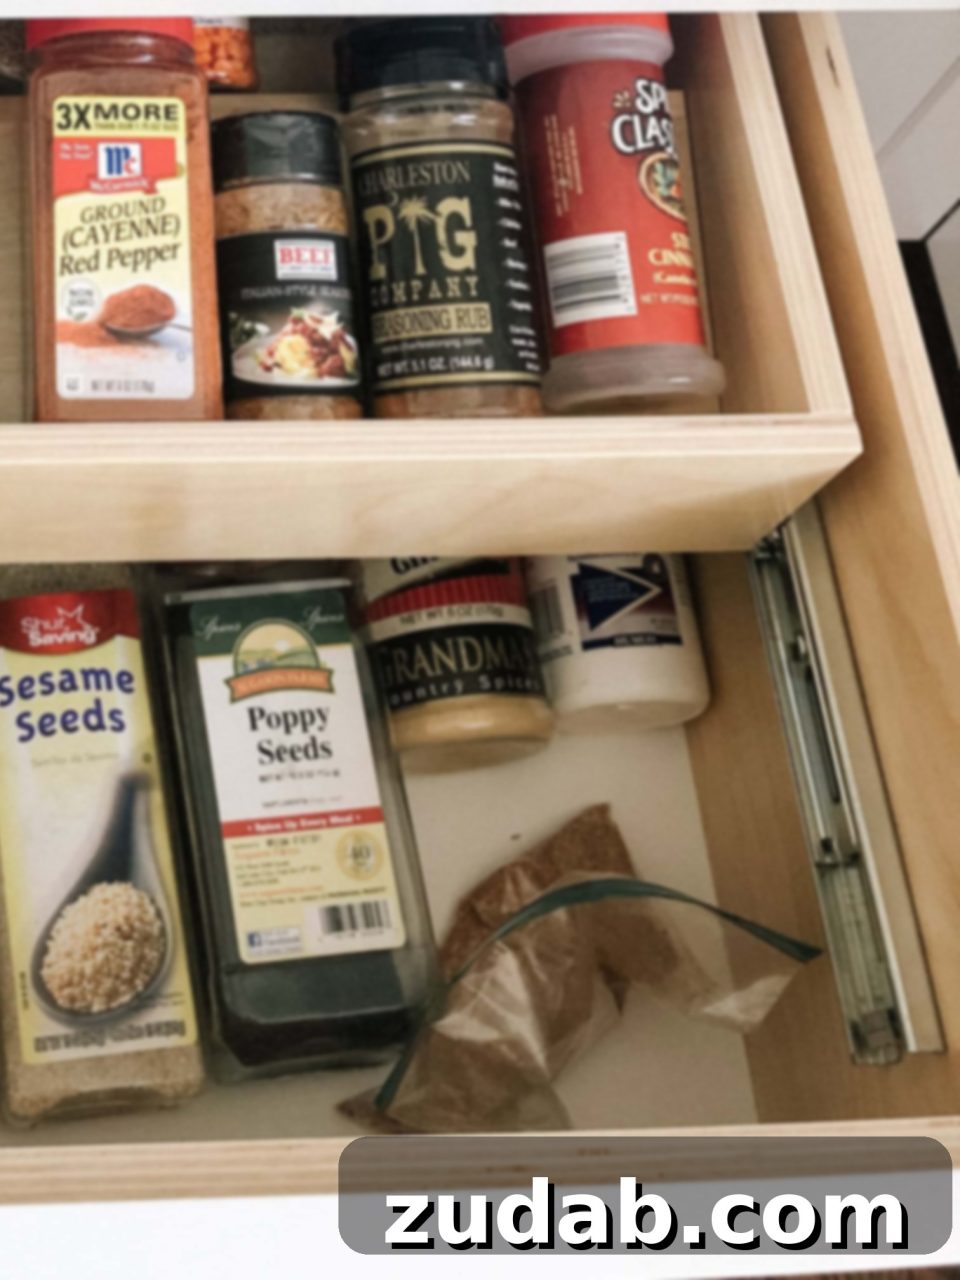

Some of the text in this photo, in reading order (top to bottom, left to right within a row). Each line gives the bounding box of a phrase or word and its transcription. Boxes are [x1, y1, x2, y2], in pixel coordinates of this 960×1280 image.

[93, 103, 180, 122] MORE
[359, 160, 471, 194] CHARLESTON
[80, 197, 167, 225] GROUND
[62, 213, 182, 255] (CAYENNE)
[59, 243, 181, 277] Red Pepper
[371, 276, 478, 306] COMPANY
[374, 305, 489, 341] SEASONING RUB
[15, 697, 126, 744] Seeds
[247, 706, 331, 736] Poppy
[257, 734, 334, 767] Seeds
